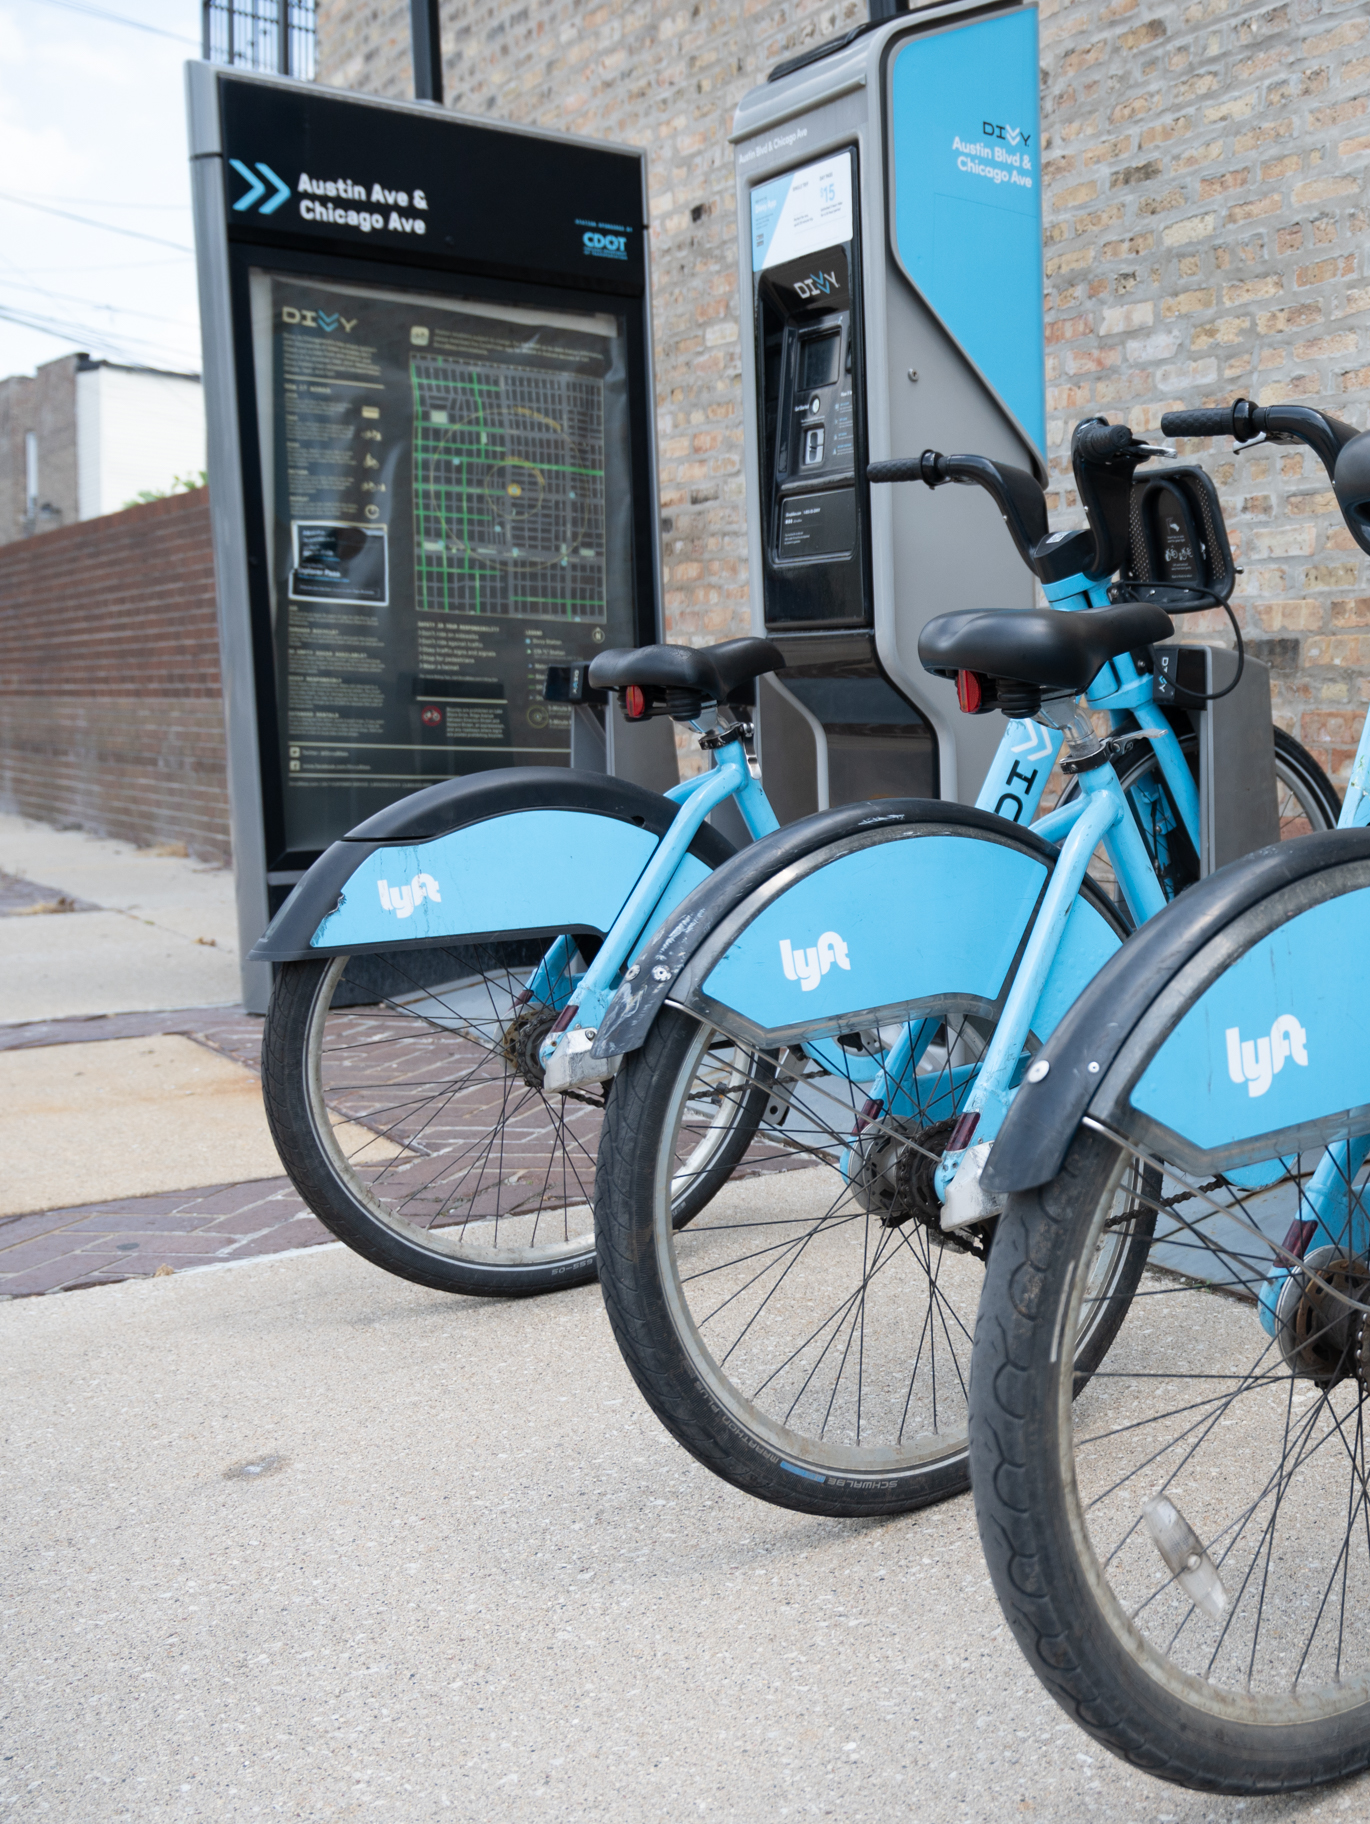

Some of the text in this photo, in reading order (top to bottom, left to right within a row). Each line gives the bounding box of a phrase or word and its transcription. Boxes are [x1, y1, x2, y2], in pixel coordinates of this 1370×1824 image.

[739, 149, 756, 165] Austin
[773, 133, 797, 150] Chicago
[797, 128, 808, 139] Ave
[952, 135, 1032, 171] Austin Blvd &
[297, 172, 429, 210] Austin Ave &
[957, 156, 1033, 189] Chicago Ave
[299, 198, 427, 235] Chicago Ave
[582, 231, 627, 252] CDOT
[377, 873, 442, 919] lyft
[779, 930, 851, 992] lyft
[1225, 1013, 1309, 1098] lyft
[693, 1381, 899, 1490] SCHWALBE MARATHON PLUS
